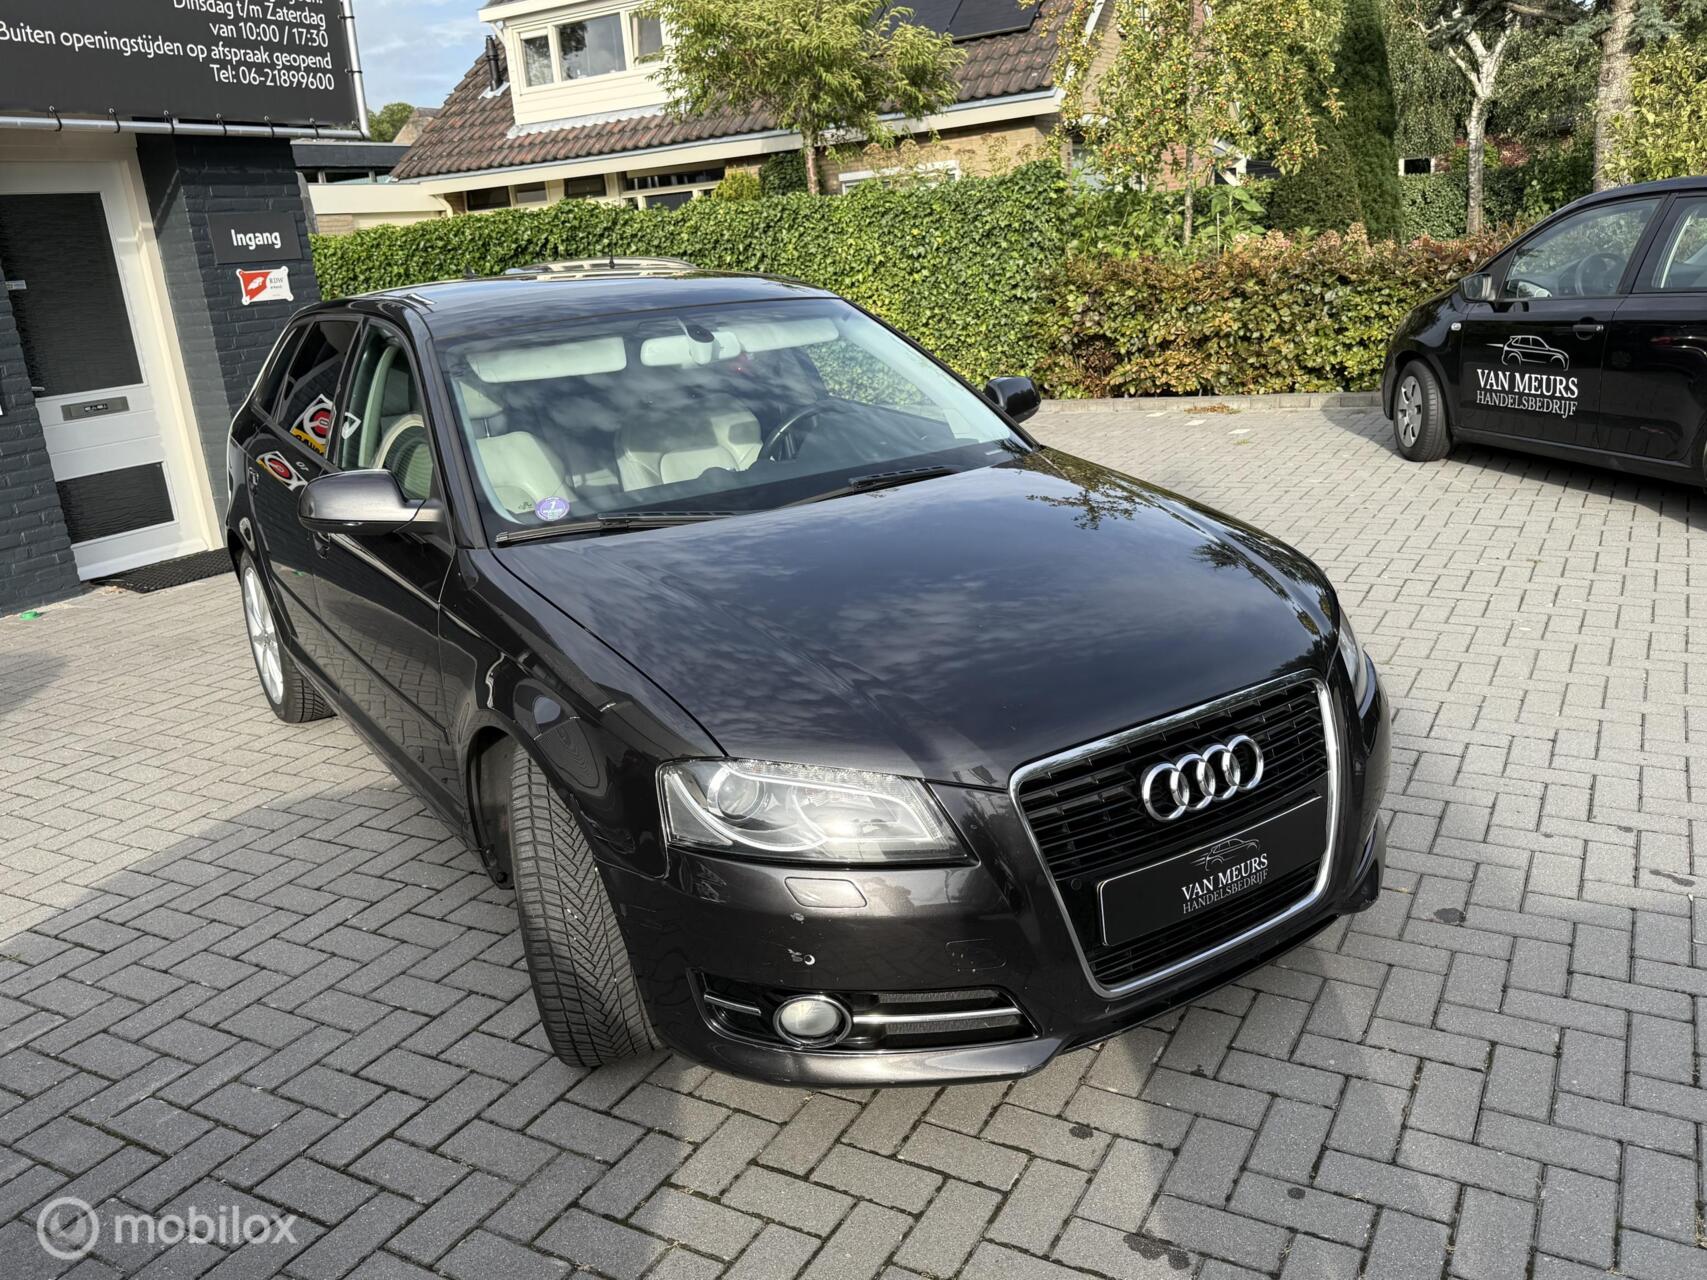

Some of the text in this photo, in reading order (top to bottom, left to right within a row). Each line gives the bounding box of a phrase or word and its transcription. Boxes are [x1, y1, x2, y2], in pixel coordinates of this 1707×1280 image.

[236, 0, 262, 18] t/m
[264, 2, 326, 30] Zaterdag
[0, 20, 332, 71] Buiten openingstijden op afspraak geopend
[209, 22, 329, 47] van 10:00 / 17:30
[209, 64, 335, 90] Tel: 06-21899600
[230, 229, 282, 250] Ingang
[1476, 369, 1579, 398] VAN MEURS
[1476, 390, 1578, 419] HANDELSBEDRIJF
[1181, 853, 1268, 900] VAN MEURS
[1183, 868, 1269, 914] HANDELSBEDRIJF
